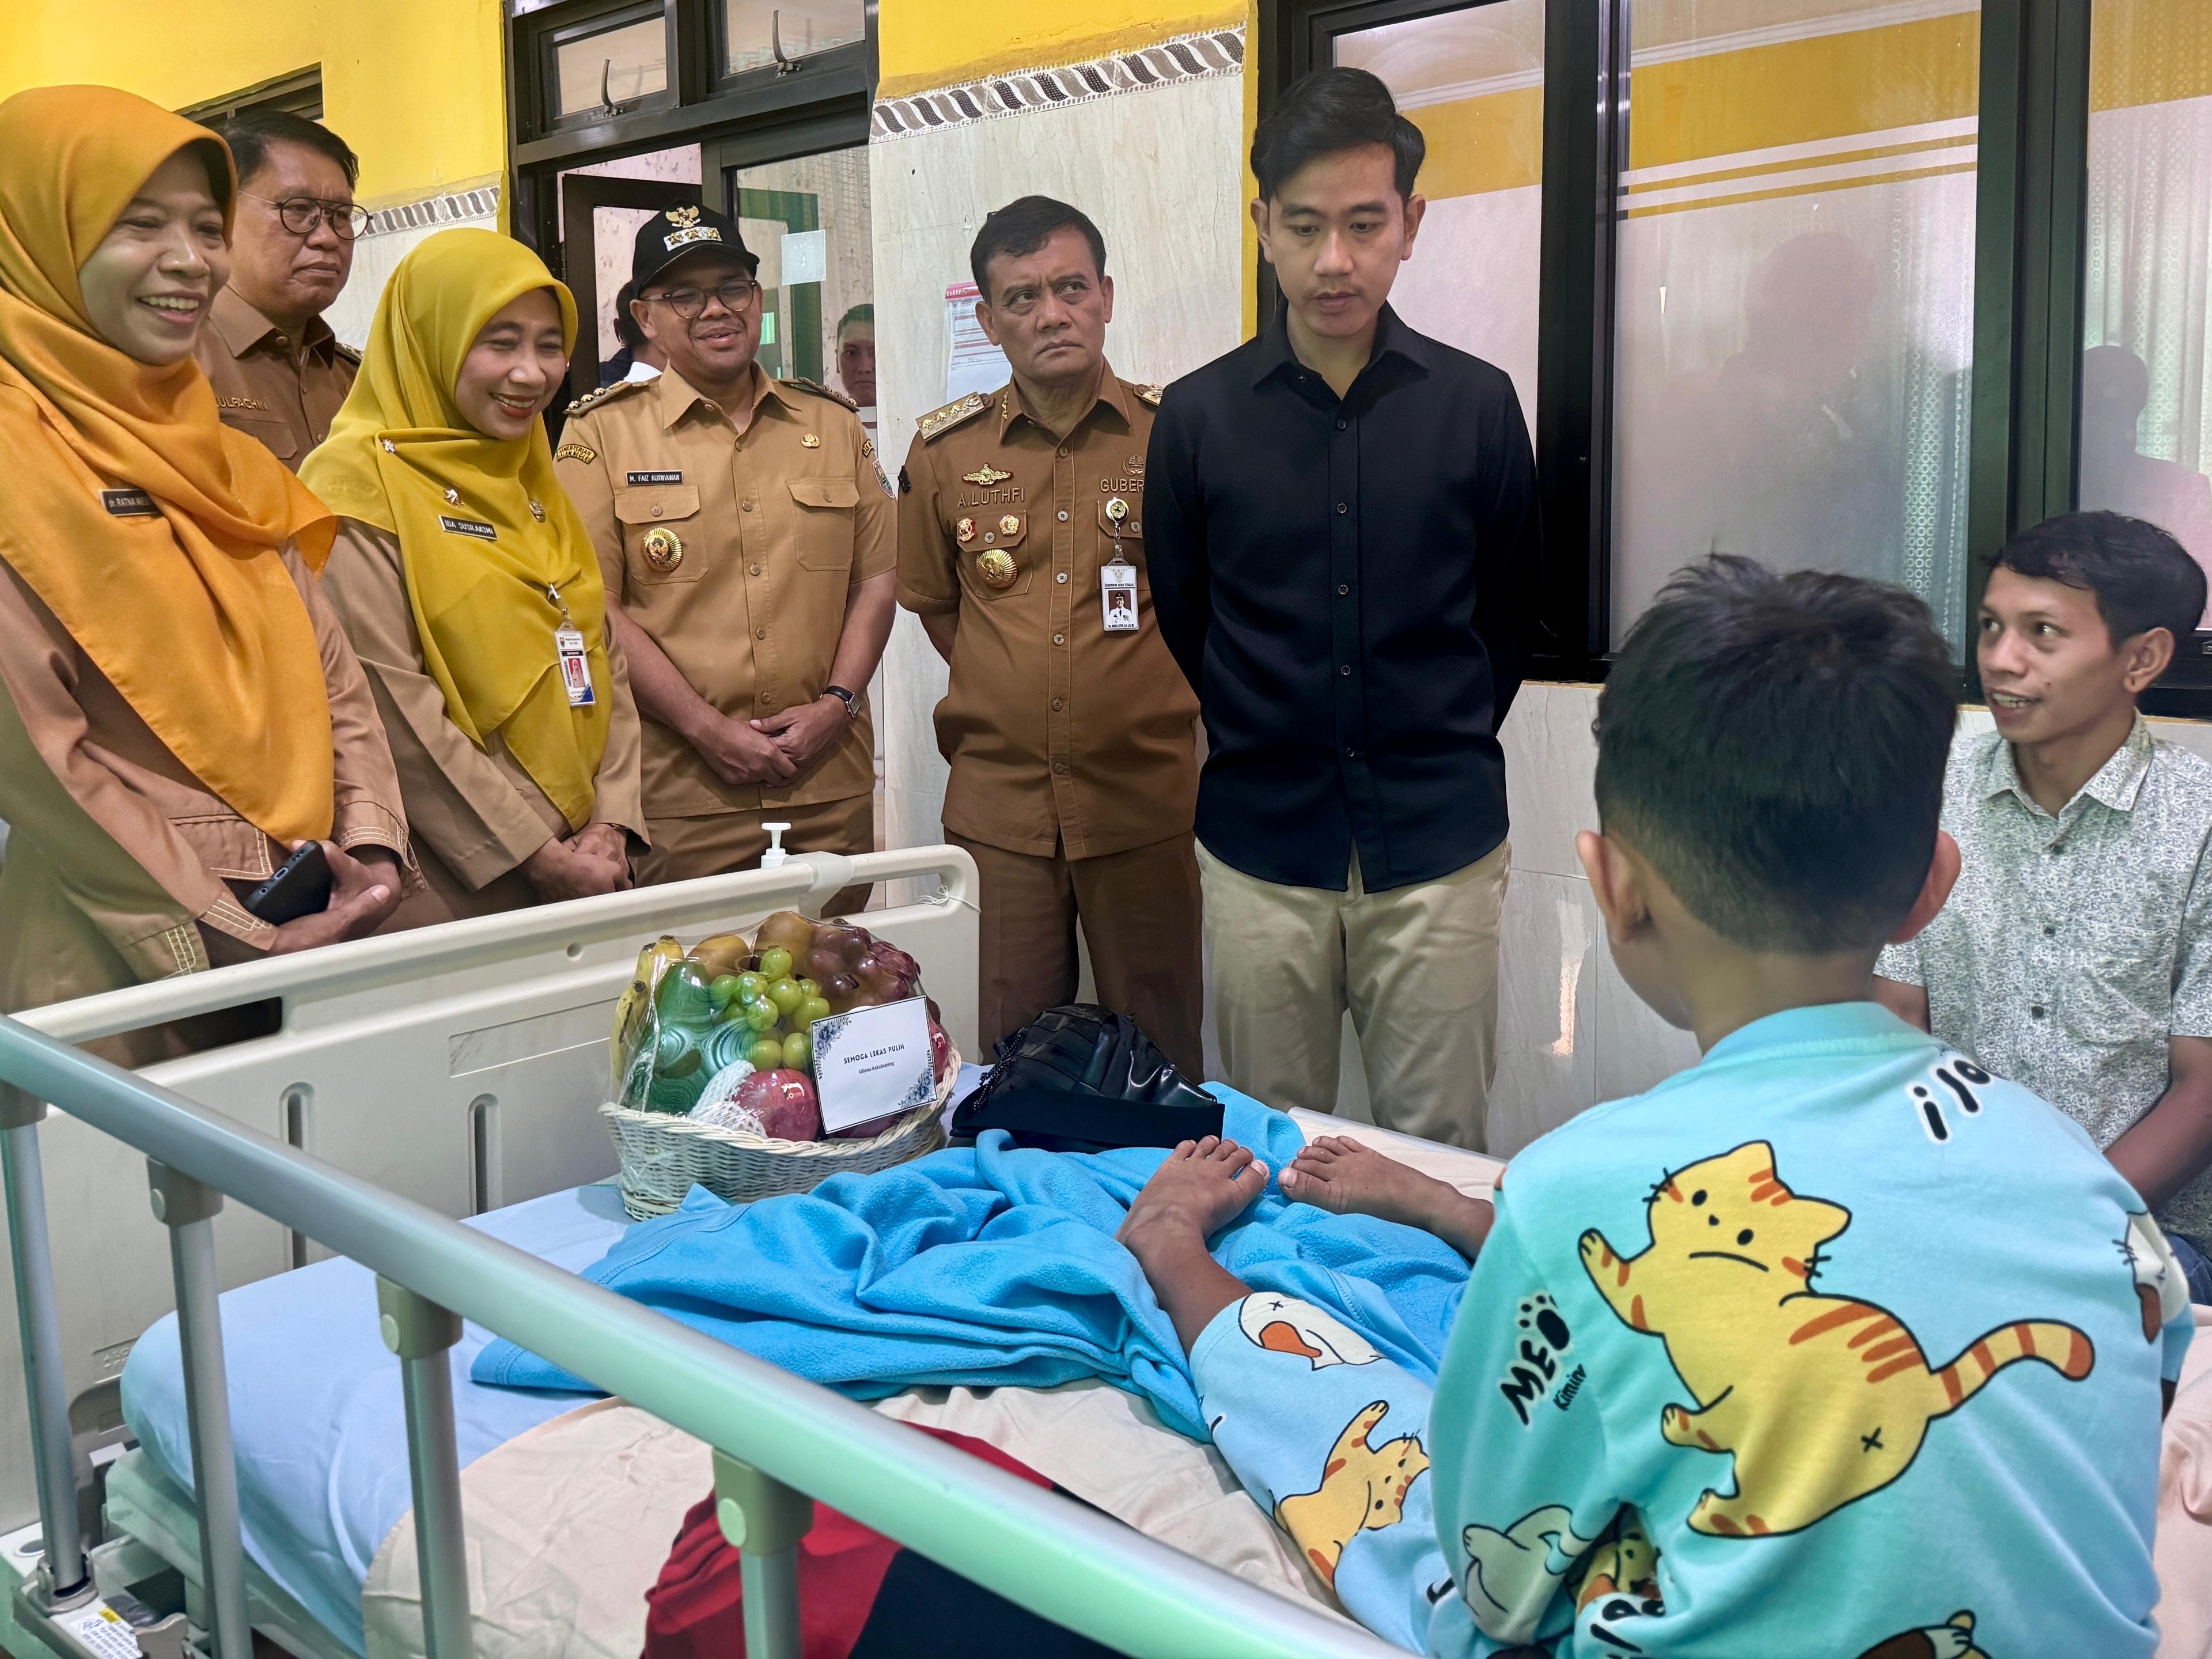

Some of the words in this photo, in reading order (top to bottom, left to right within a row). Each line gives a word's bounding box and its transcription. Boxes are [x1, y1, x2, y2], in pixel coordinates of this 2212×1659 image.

[957, 487, 1025, 509] A.LUTHFI
[444, 520, 456, 528] IDA
[843, 1052, 868, 1064] SEMOGA
[869, 1048, 887, 1058] LEKAS
[888, 1043, 904, 1053] PULIH
